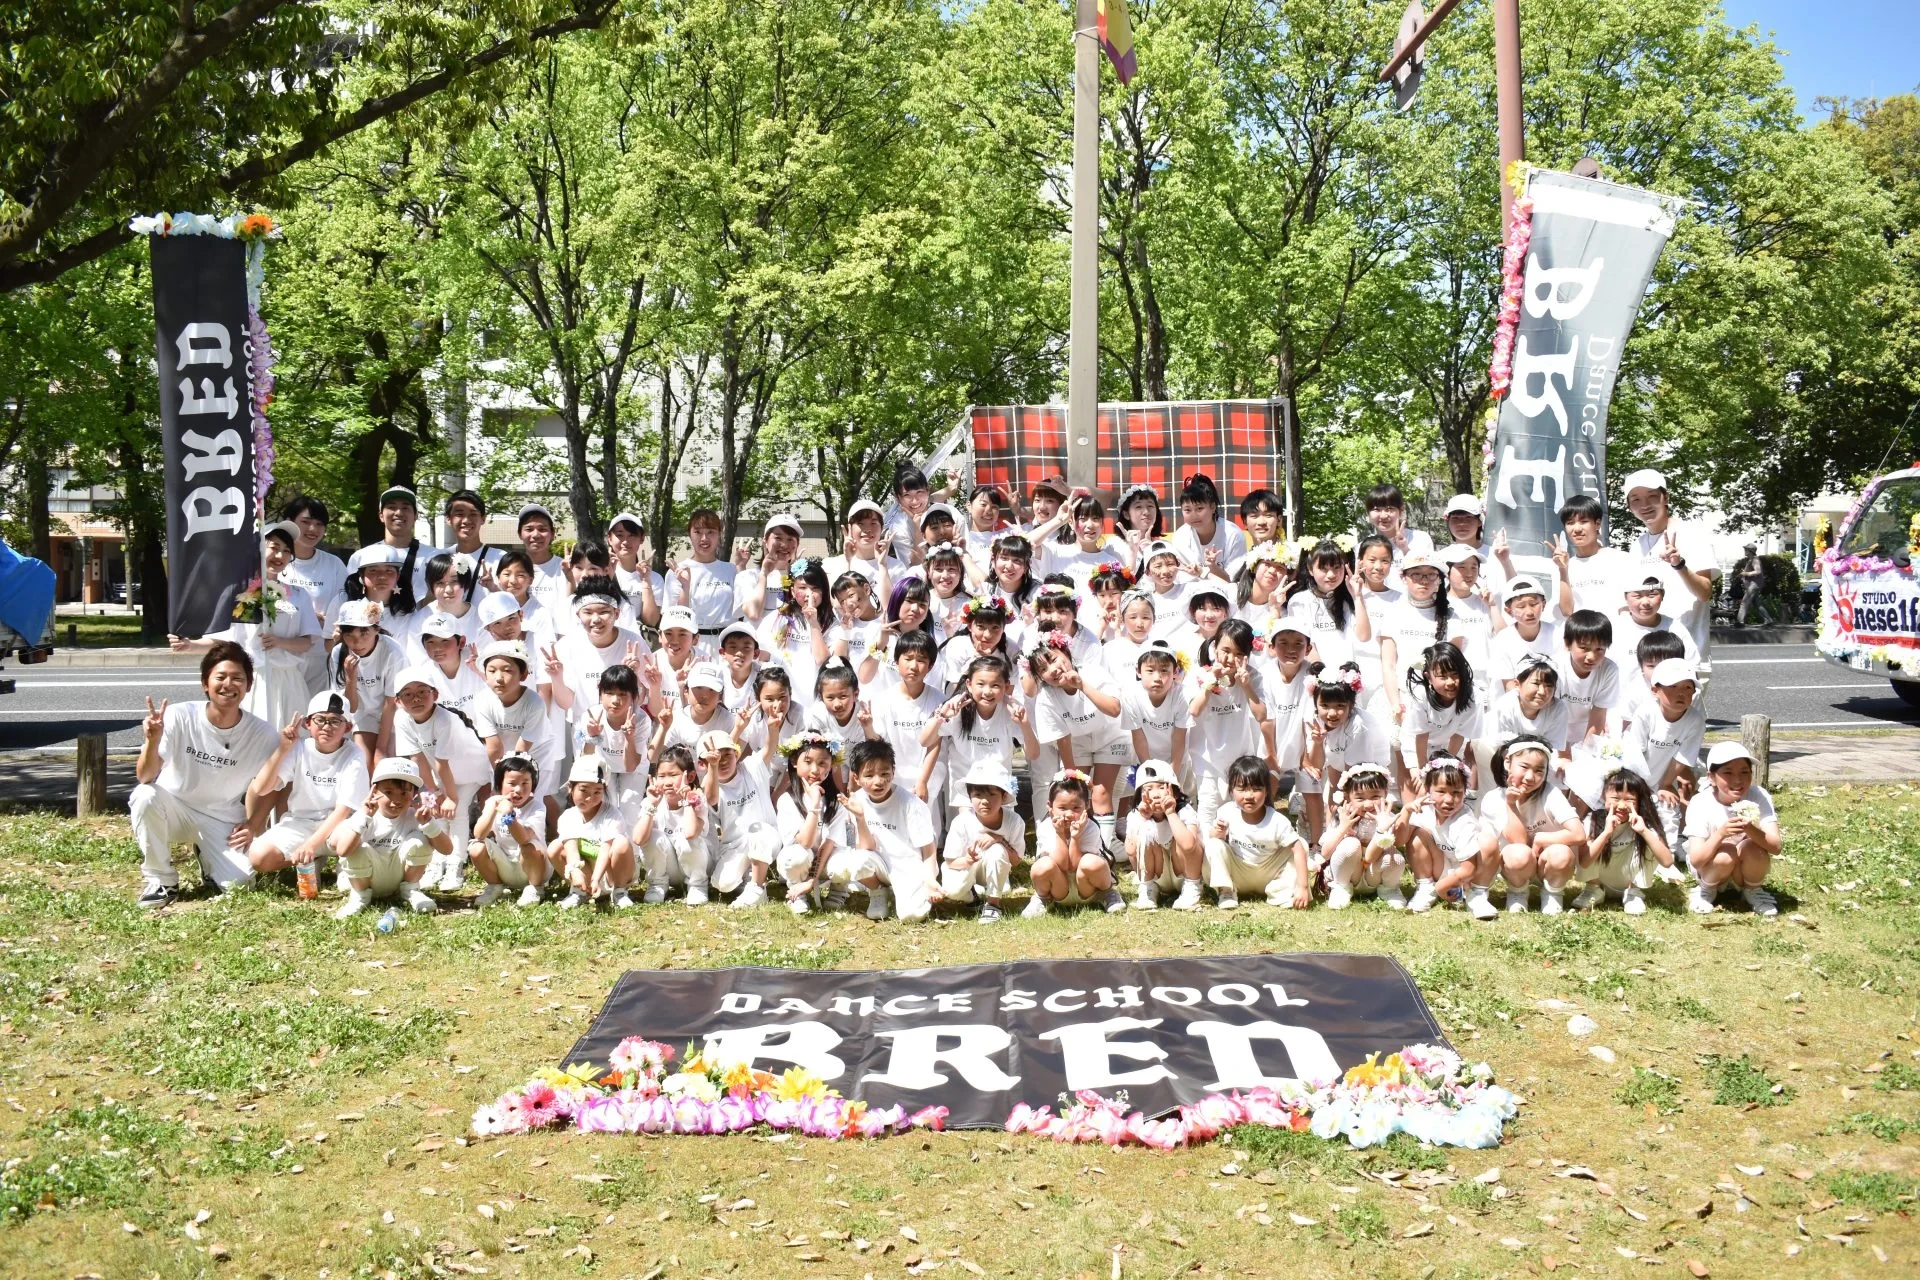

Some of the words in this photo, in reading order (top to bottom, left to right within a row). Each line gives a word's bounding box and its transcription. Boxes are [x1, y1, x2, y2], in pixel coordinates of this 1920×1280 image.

[290, 578, 325, 588] BRDCREW
[1862, 591, 1897, 605] STUDIO
[186, 745, 238, 767] BREDCREW
[305, 770, 337, 784] BEDCRE
[713, 991, 974, 1017] DANCE
[999, 982, 1310, 1016] SCHOOL
[702, 1016, 1343, 1093] BRED
